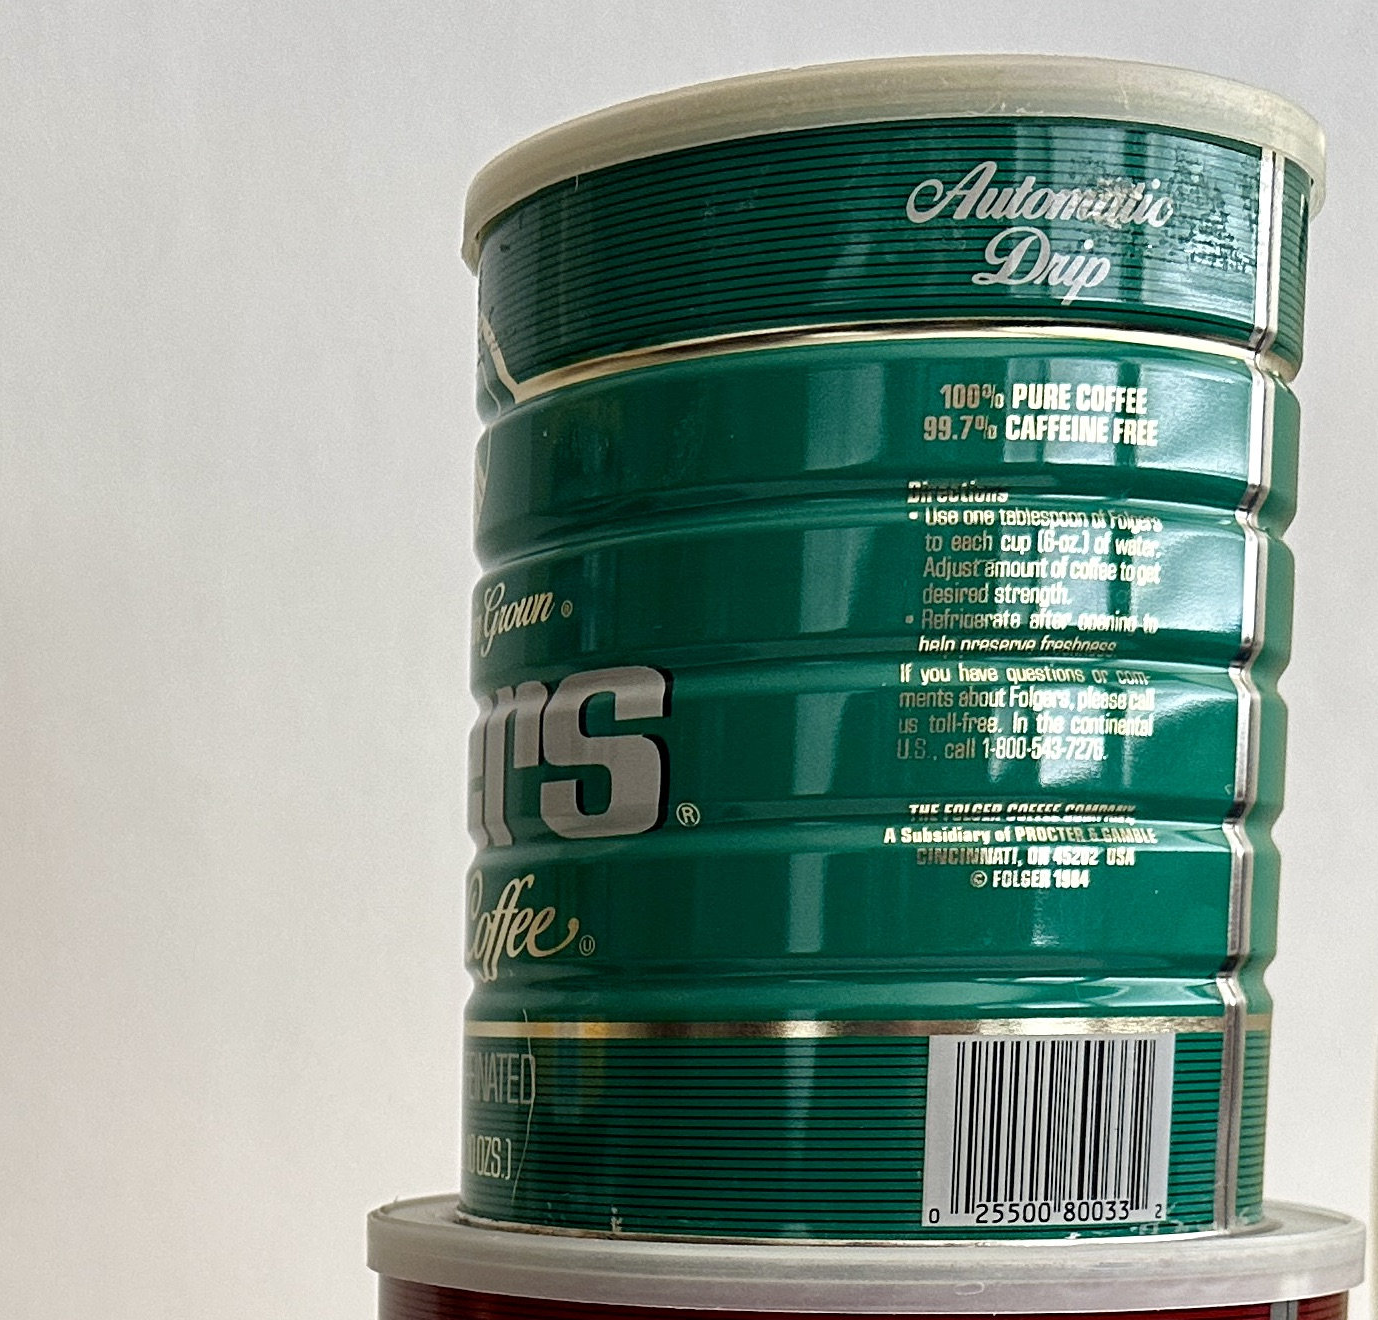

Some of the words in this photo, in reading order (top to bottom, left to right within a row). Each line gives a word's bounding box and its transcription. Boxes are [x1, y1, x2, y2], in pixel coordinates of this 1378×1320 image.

[906, 161, 1174, 229] Automatic
[971, 226, 1111, 305] Drip
[940, 384, 1004, 409] 100%
[1011, 384, 1070, 410] PURE
[1076, 385, 1147, 414] COFFEE
[923, 415, 997, 441] 99.7%
[1005, 415, 1108, 445] CAFFEINE
[1112, 417, 1157, 447] FREE
[926, 510, 958, 526] Use
[963, 510, 994, 525] one
[922, 583, 989, 604] desired
[994, 582, 1071, 608] strength.
[480, 581, 554, 658] Grown
[944, 741, 976, 760] call
[982, 736, 1108, 760] 1-800-543-7276.
[993, 870, 1051, 888] FOLGER
[1053, 870, 1090, 889] 1984
[929, 1208, 940, 1224] 0
[976, 1202, 1051, 1224] 25500
[1063, 1200, 1130, 1221] 80033
[1155, 1204, 1162, 1219] 2
